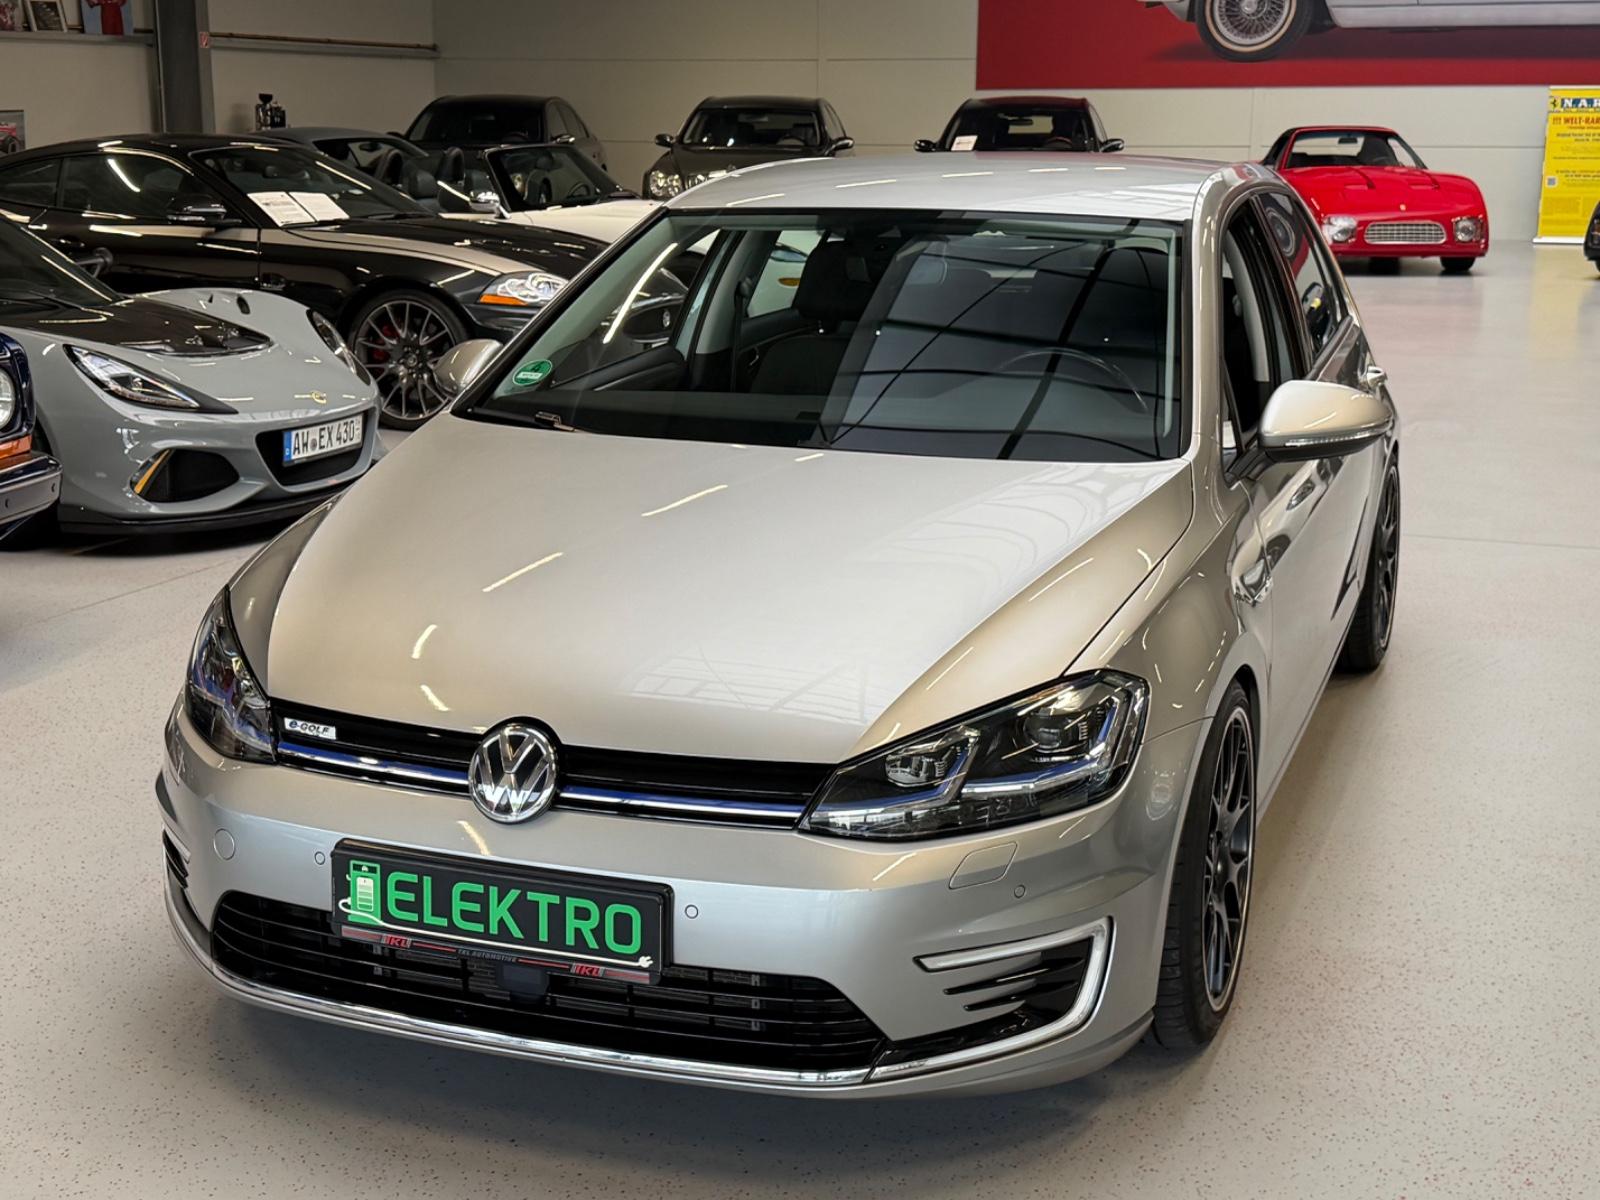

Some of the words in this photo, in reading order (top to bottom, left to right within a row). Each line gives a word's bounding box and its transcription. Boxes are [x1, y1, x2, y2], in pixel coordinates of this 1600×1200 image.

[318, 425, 334, 450] EX
[335, 420, 355, 445] 430
[387, 871, 642, 955] ELEKTRO
